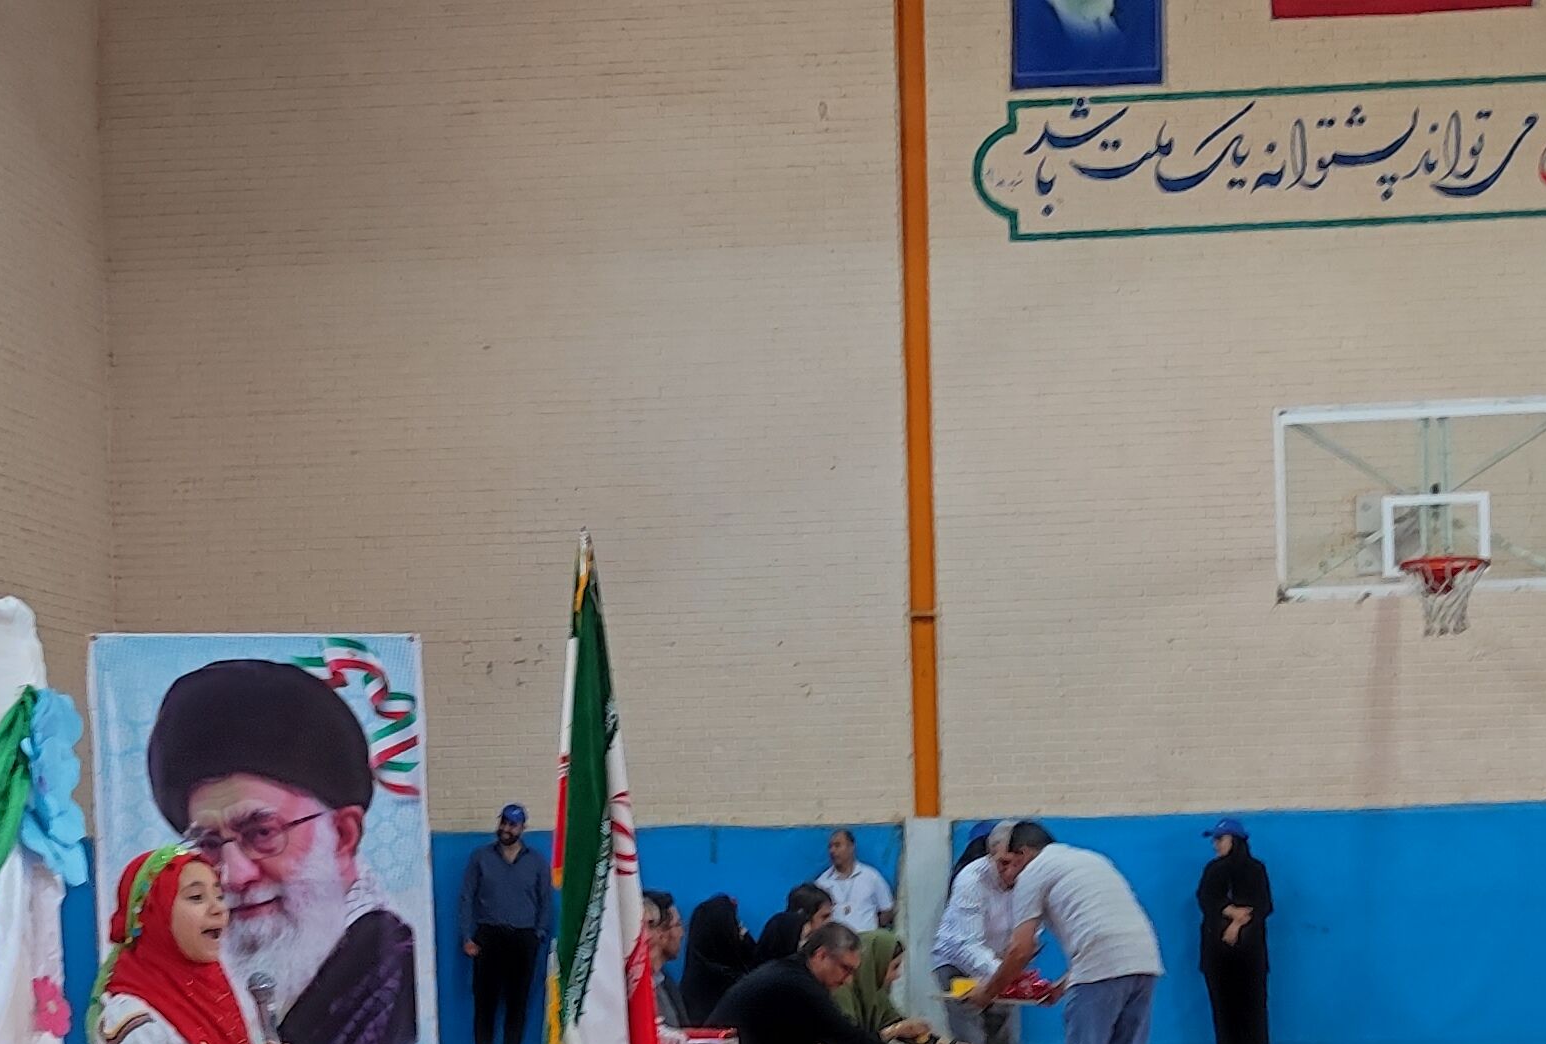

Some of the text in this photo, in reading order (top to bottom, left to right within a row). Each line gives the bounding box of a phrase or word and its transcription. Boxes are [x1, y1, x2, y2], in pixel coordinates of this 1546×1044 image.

[1069, 119, 1175, 180] ملت
[1155, 100, 1257, 193] یک
[1250, 104, 1420, 201] پشتوانه
[1401, 108, 1493, 181] تواند
[1430, 111, 1539, 198] می
